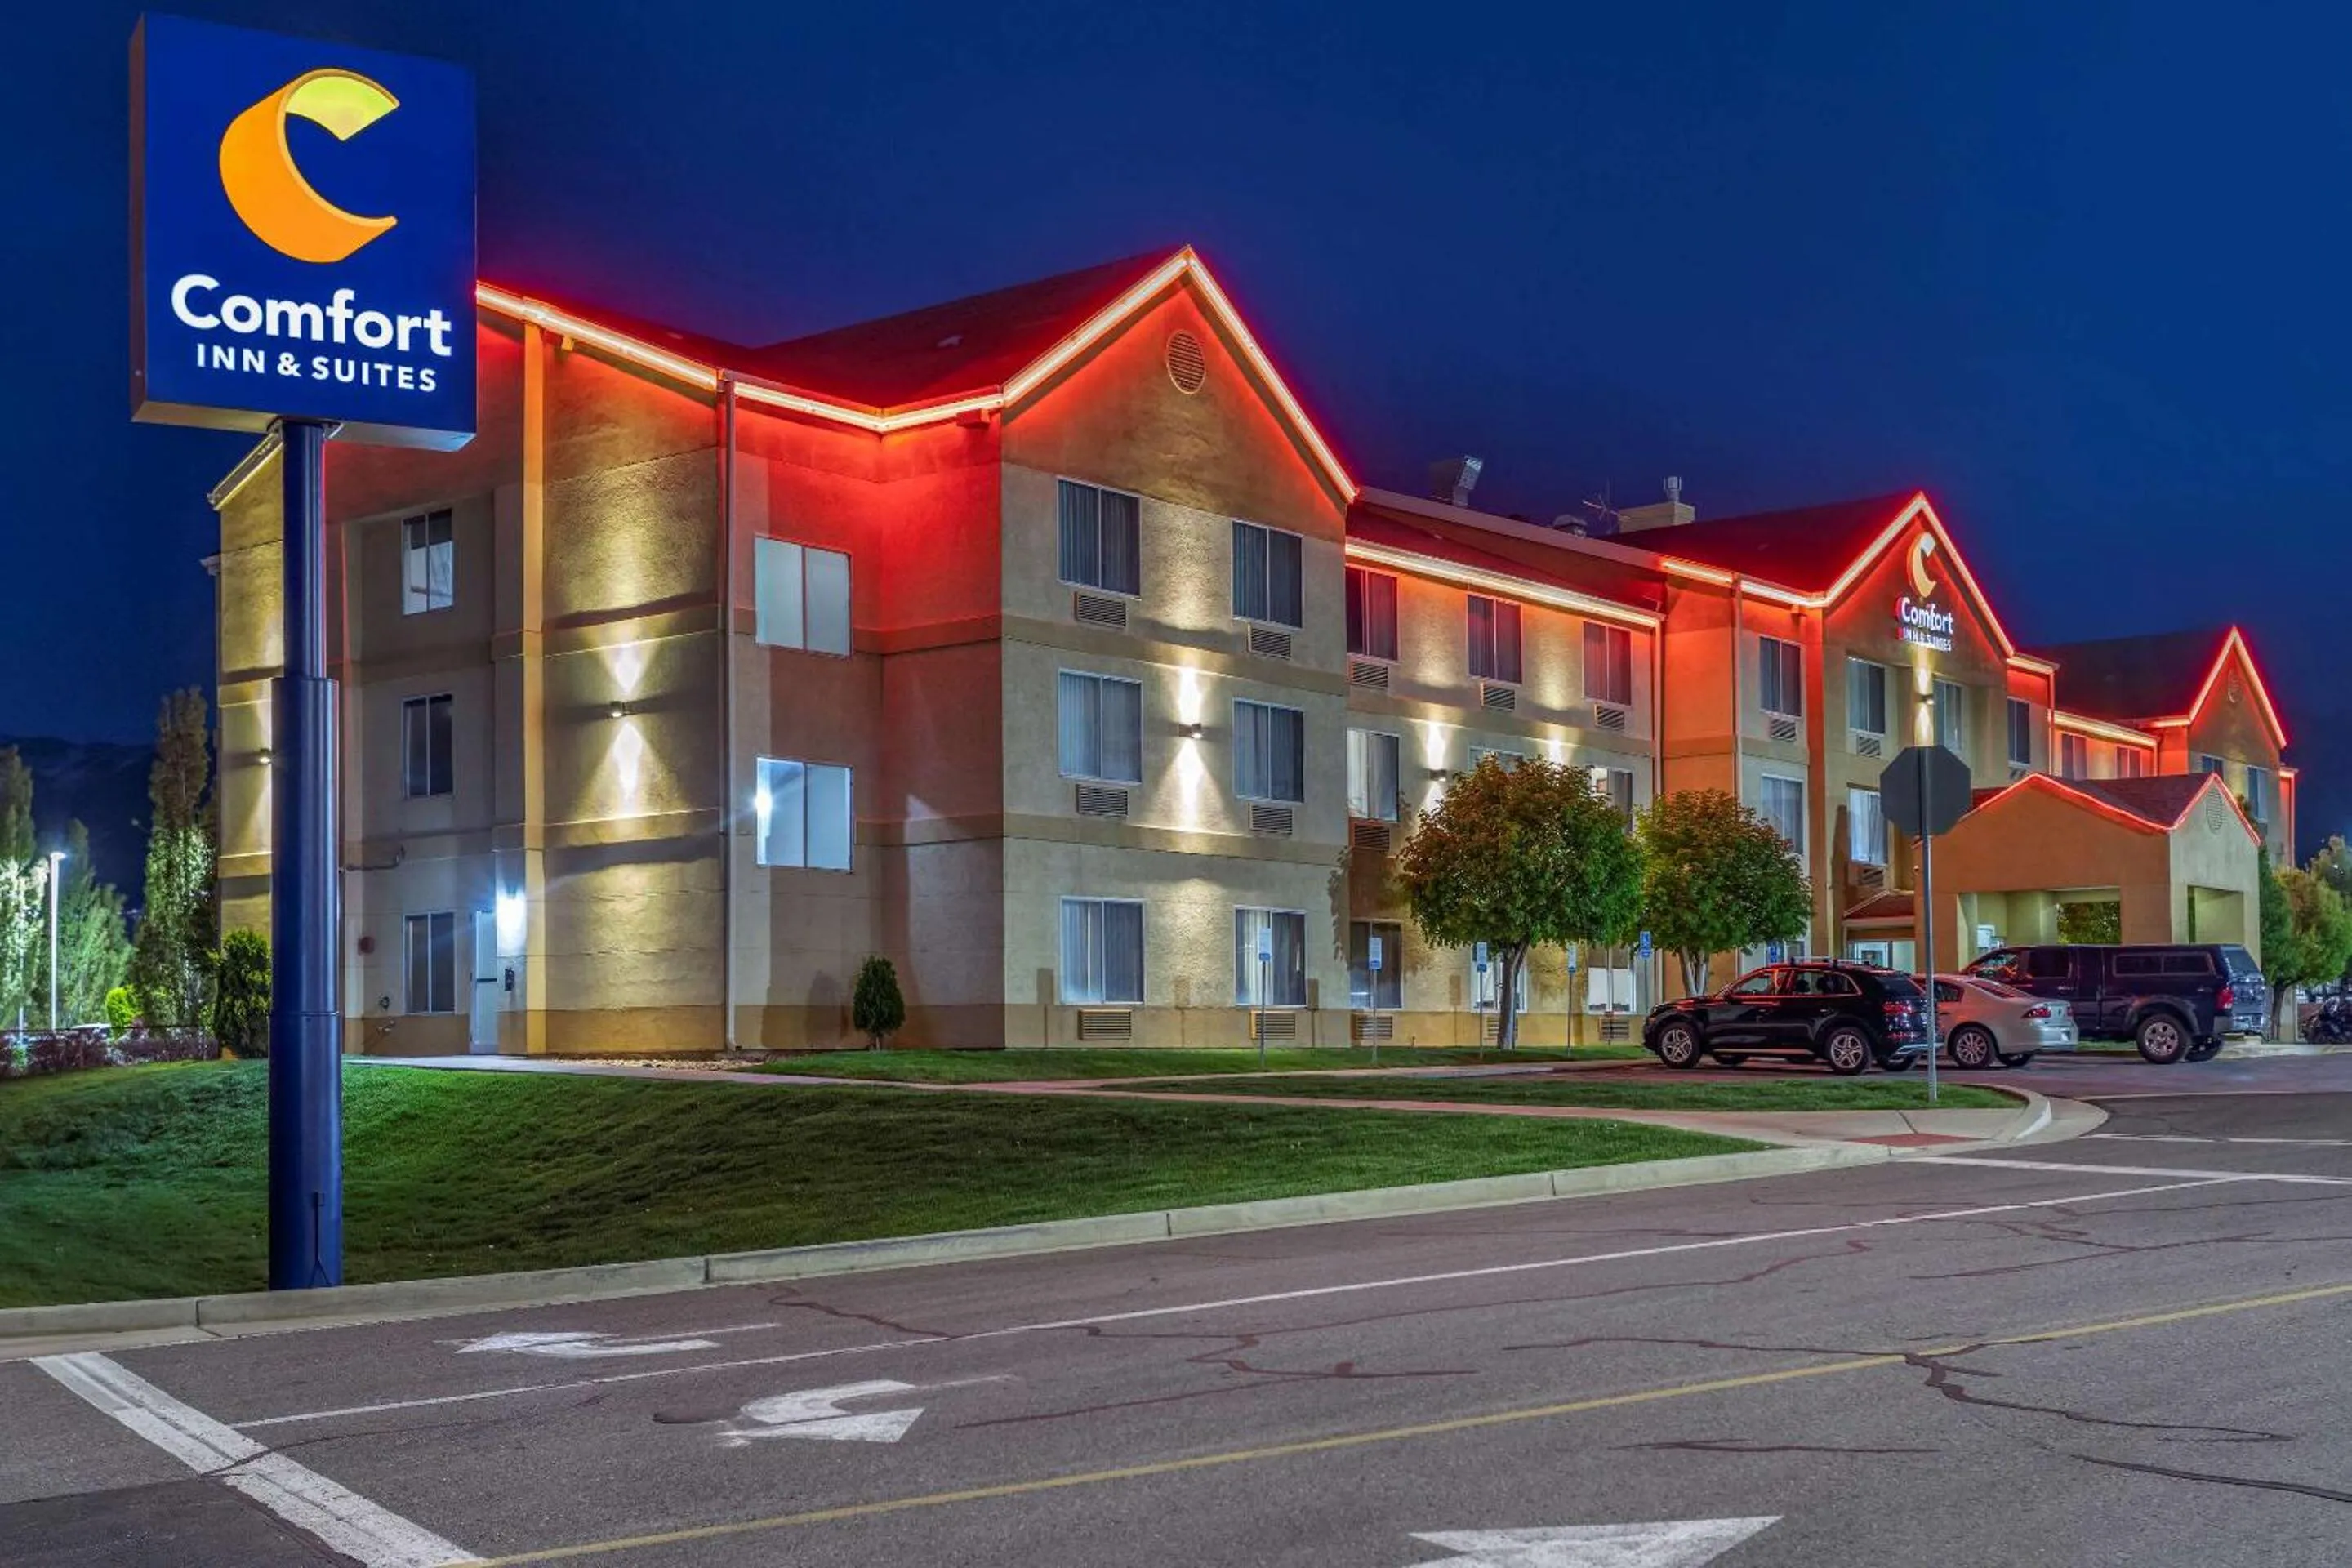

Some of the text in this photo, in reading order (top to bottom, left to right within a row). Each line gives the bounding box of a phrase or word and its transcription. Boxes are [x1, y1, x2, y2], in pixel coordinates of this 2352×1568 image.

[171, 274, 452, 357] Comfort
[197, 343, 436, 393] INN & SUITES
[1900, 596, 1953, 635] Comfort
